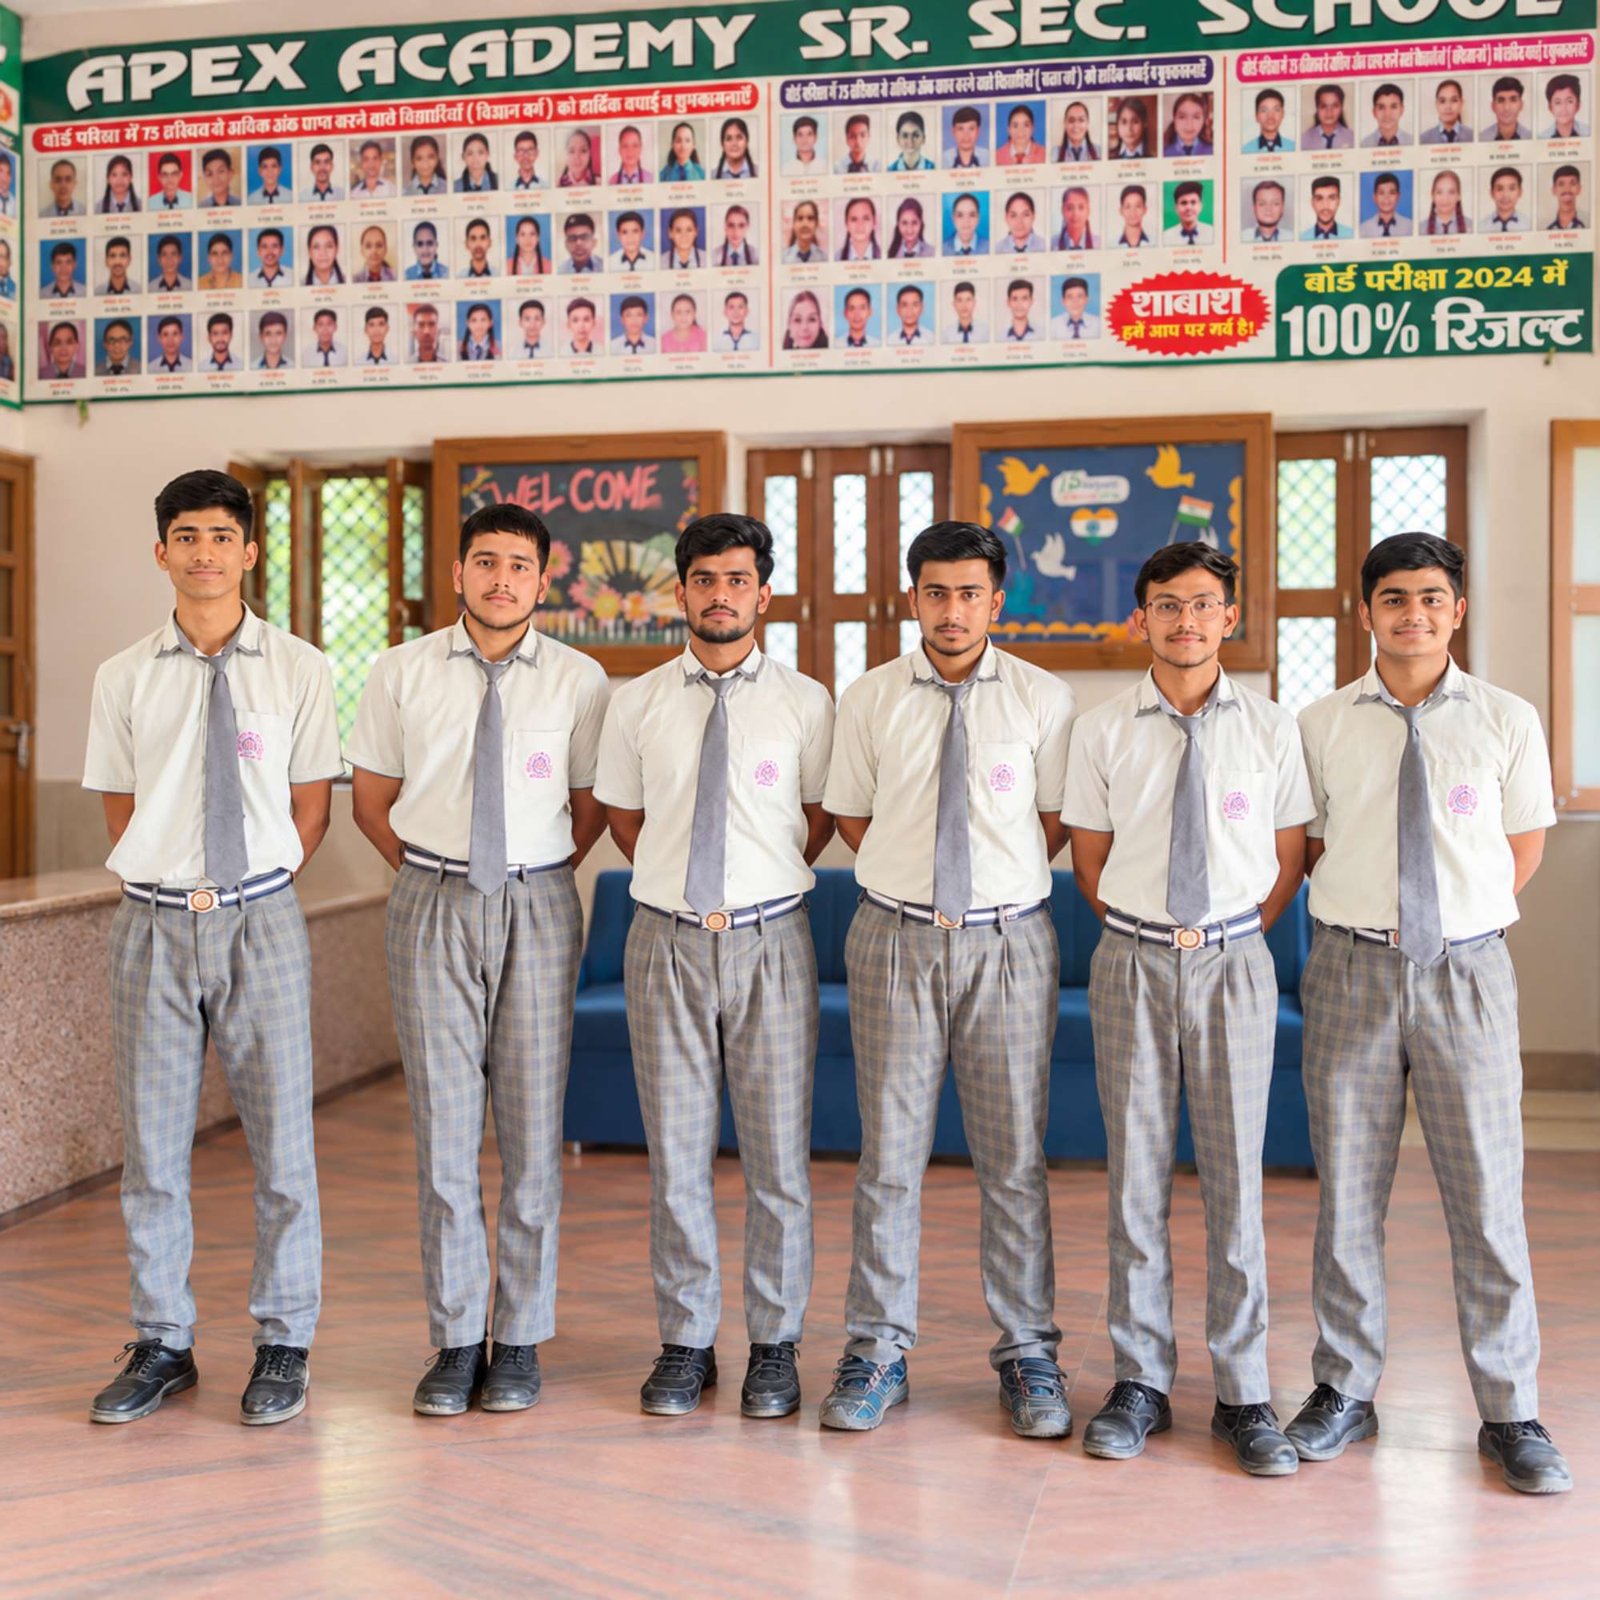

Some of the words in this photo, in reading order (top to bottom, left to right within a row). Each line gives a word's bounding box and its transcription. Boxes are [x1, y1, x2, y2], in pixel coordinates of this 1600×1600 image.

[66, 40, 307, 112] APEX
[337, 14, 757, 94] ACADEMY
[799, 9, 929, 61] SR.
[968, 0, 1147, 49] SEC.
[142, 126, 160, 141] 75
[1304, 263, 1358, 294] बोर्ड
[1364, 261, 1449, 292] परीक्षा
[1454, 266, 1534, 289] 2024
[1542, 259, 1569, 287] में
[1130, 287, 1245, 318] शाबाश
[1149, 323, 1181, 338] आप
[1184, 323, 1206, 337] पर
[1281, 301, 1420, 357] 100%
[1431, 296, 1585, 351] रिजल्ट
